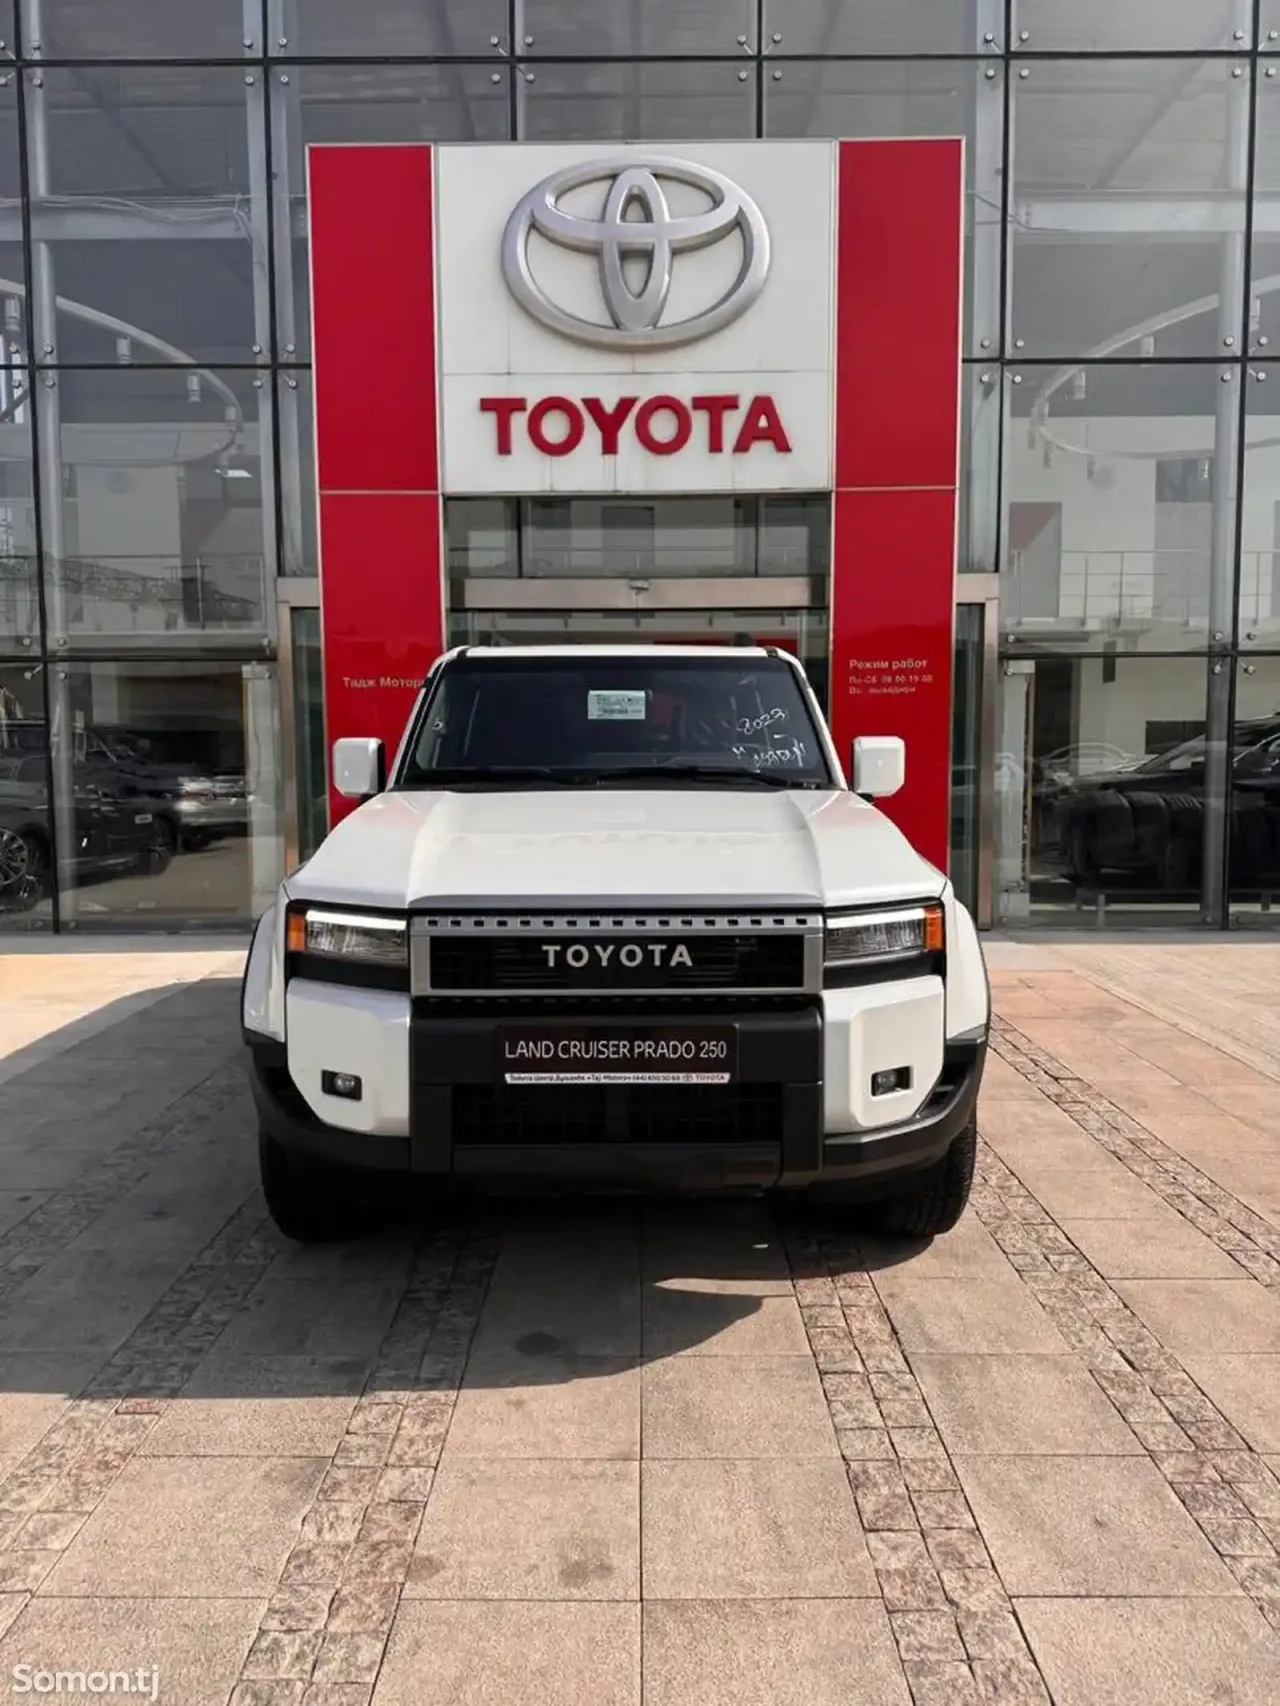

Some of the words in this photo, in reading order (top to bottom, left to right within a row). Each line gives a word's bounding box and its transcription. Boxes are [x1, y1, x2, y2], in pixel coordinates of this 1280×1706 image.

[480, 395, 793, 456] TOYOTA
[849, 659, 889, 669] Режим
[380, 676, 421, 689] Мотор
[541, 944, 693, 968] TOYOTA
[505, 1040, 554, 1059] LAND
[557, 1040, 631, 1059] CRUISER
[634, 1040, 695, 1059] PRADO
[699, 1040, 727, 1059] 250
